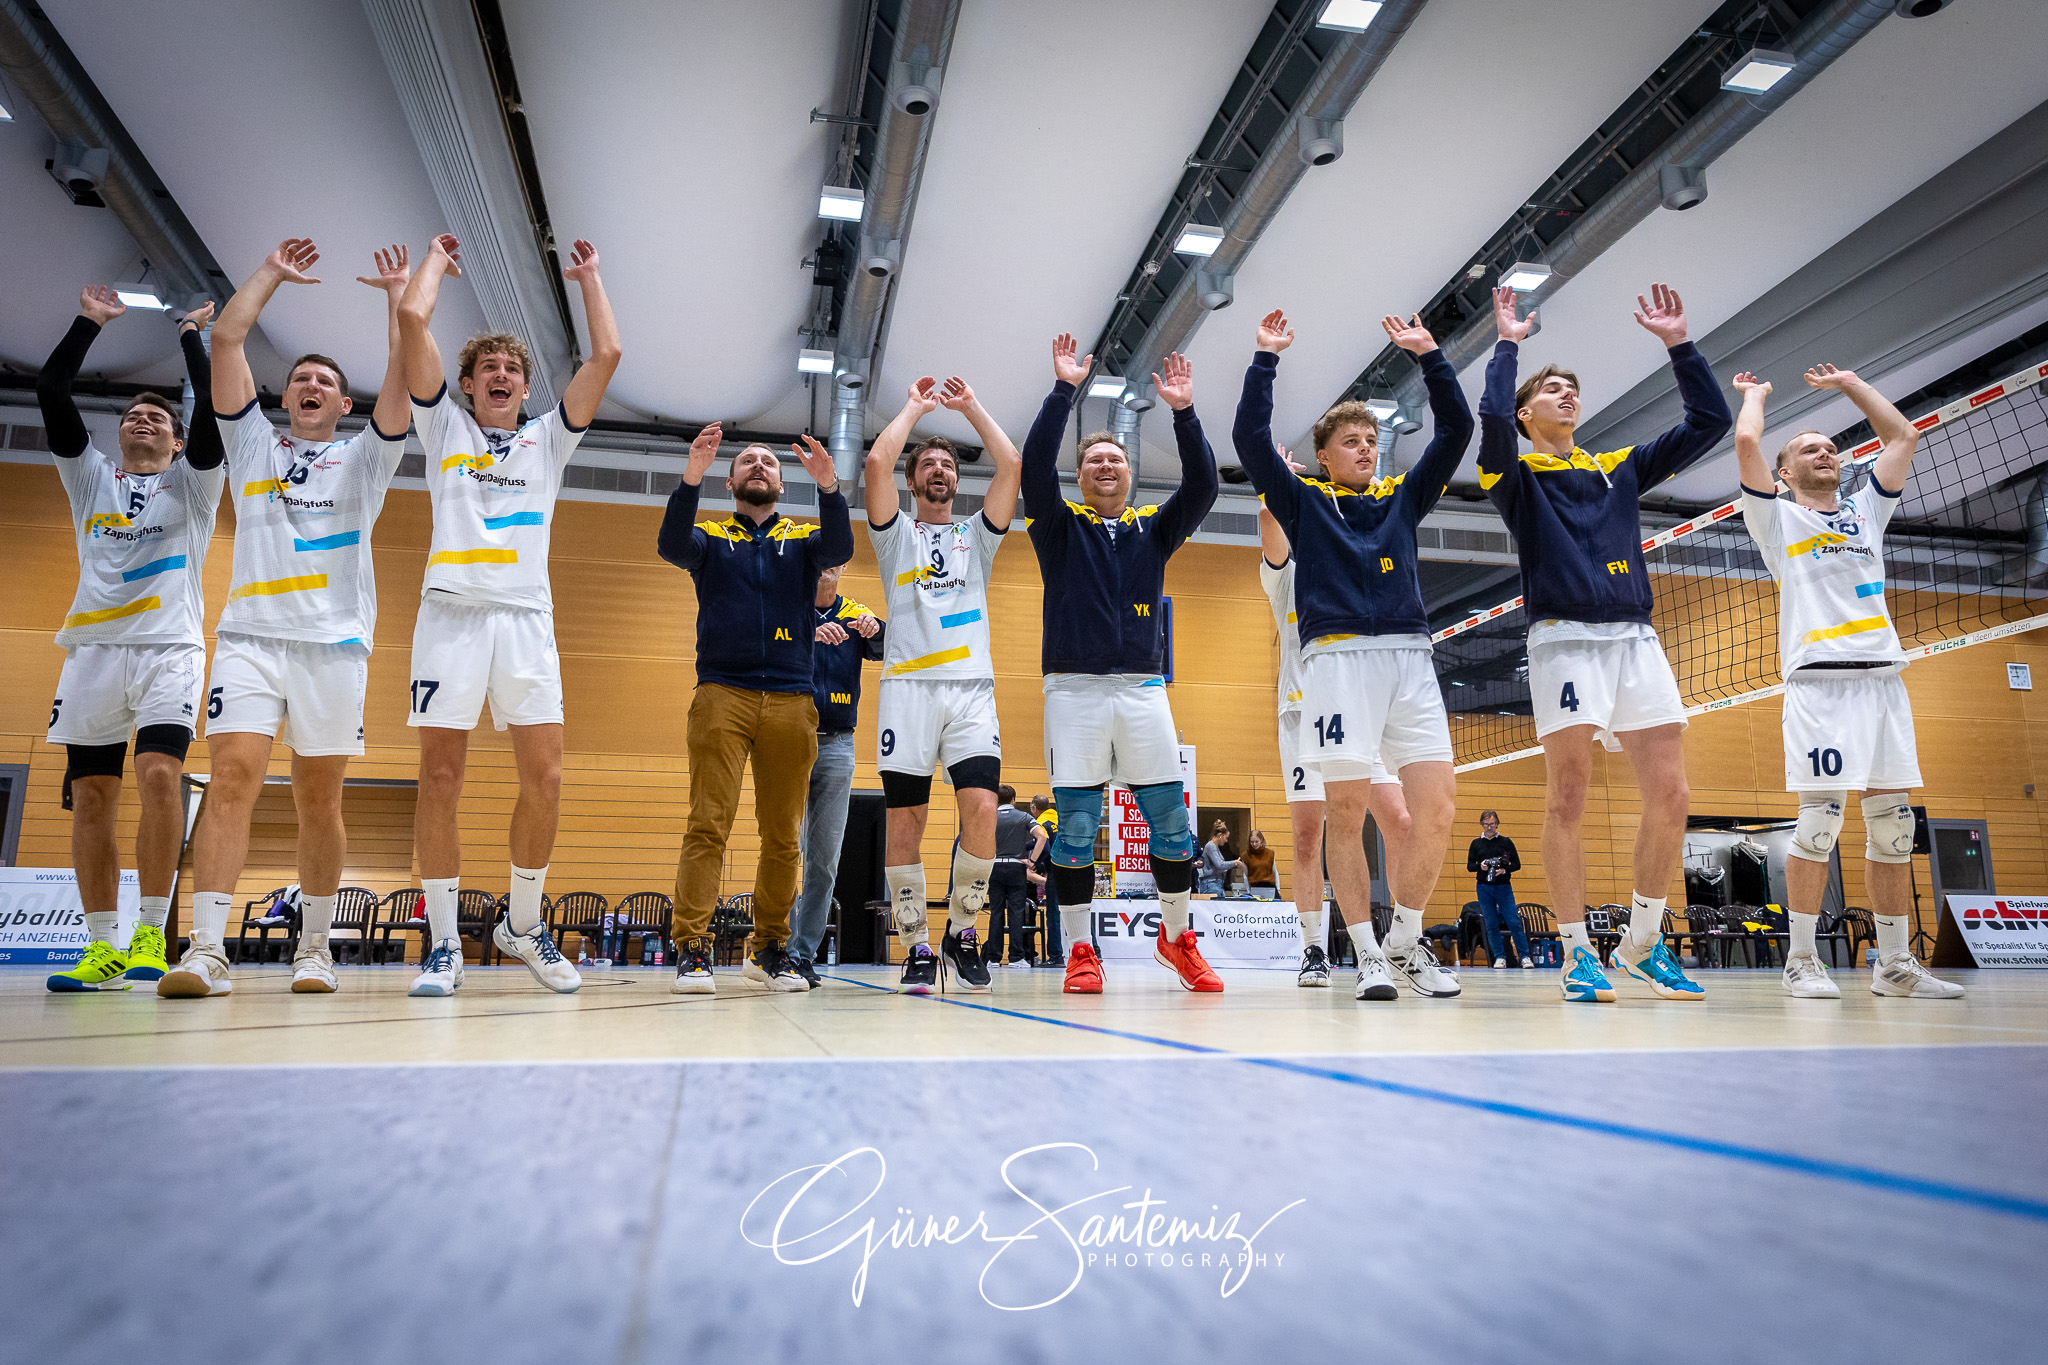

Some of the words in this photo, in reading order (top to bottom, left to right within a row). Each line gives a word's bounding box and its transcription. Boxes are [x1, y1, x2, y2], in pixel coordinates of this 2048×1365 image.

[488, 474, 526, 487] Daigfuss
[126, 491, 145, 519] 5
[930, 549, 945, 573] 9
[1380, 557, 1394, 574] JD
[1606, 559, 1629, 575] FH
[1133, 603, 1150, 617] YK
[774, 627, 793, 641] AL
[1933, 638, 1966, 653] FUCHS
[1972, 631, 1993, 642] Ideen
[1994, 622, 2031, 637] umsetzen
[207, 686, 224, 719] 5
[411, 680, 440, 713] 17
[830, 692, 851, 705] MM
[1560, 681, 1580, 713] 4
[881, 728, 896, 757] 9
[1314, 713, 1345, 748] 14
[1807, 747, 1843, 777] 10
[1292, 766, 1306, 791] 2
[1213, 928, 1298, 940] Werbetechnik
[1972, 942, 1984, 950] Ihr
[1984, 942, 2025, 951] Spezialist
[2025, 942, 2036, 950] für
